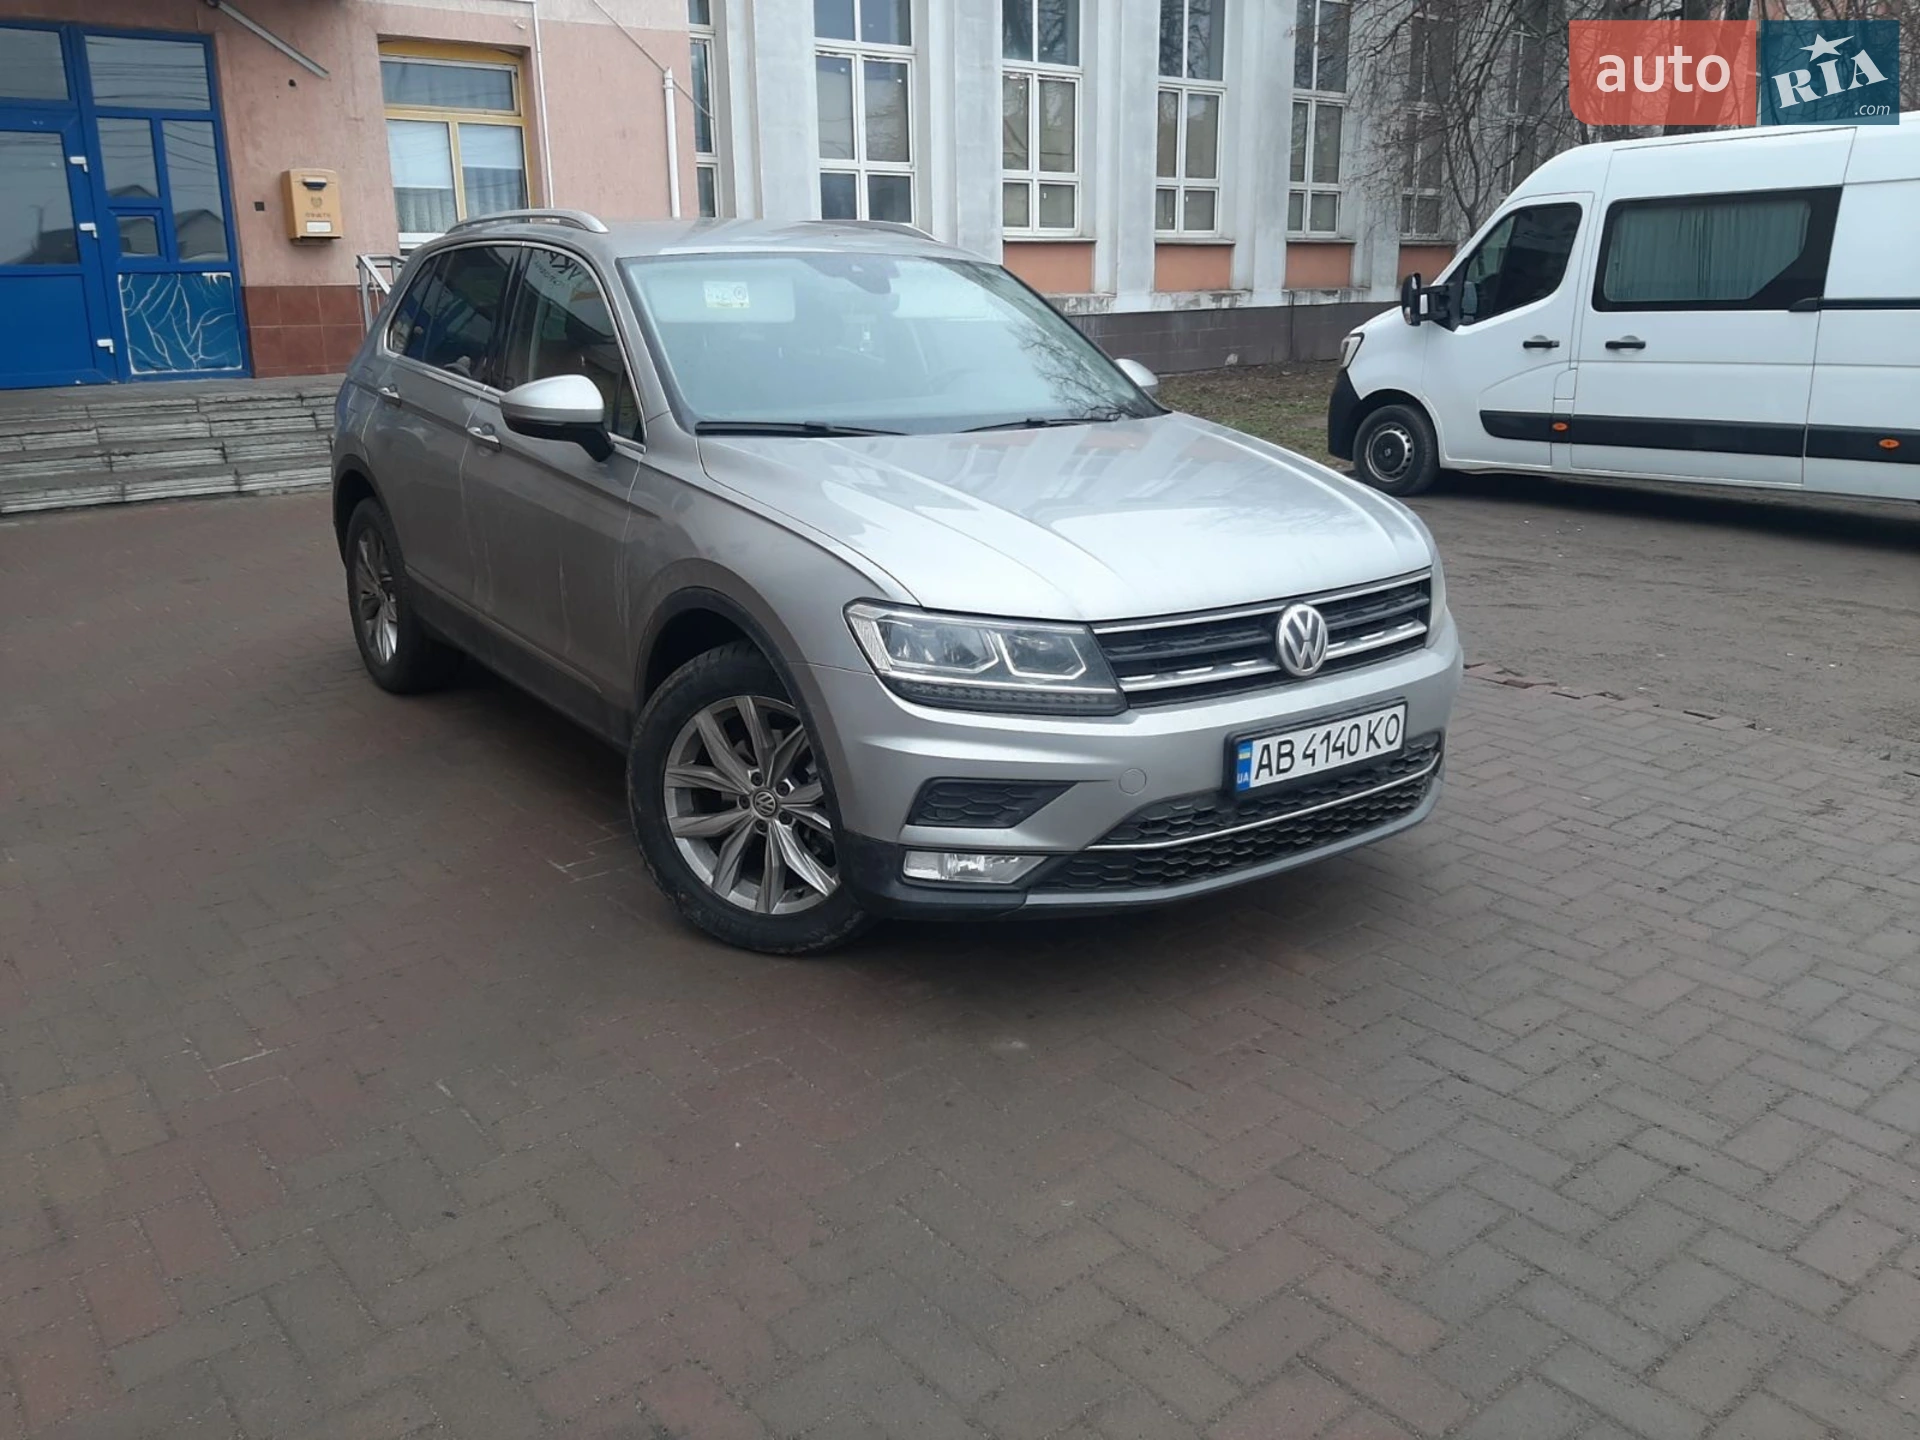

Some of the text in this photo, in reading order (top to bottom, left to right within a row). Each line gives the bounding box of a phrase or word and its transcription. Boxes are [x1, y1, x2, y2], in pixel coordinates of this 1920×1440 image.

[1254, 713, 1400, 780] AB 4140 KO
[1237, 771, 1249, 784] UA
